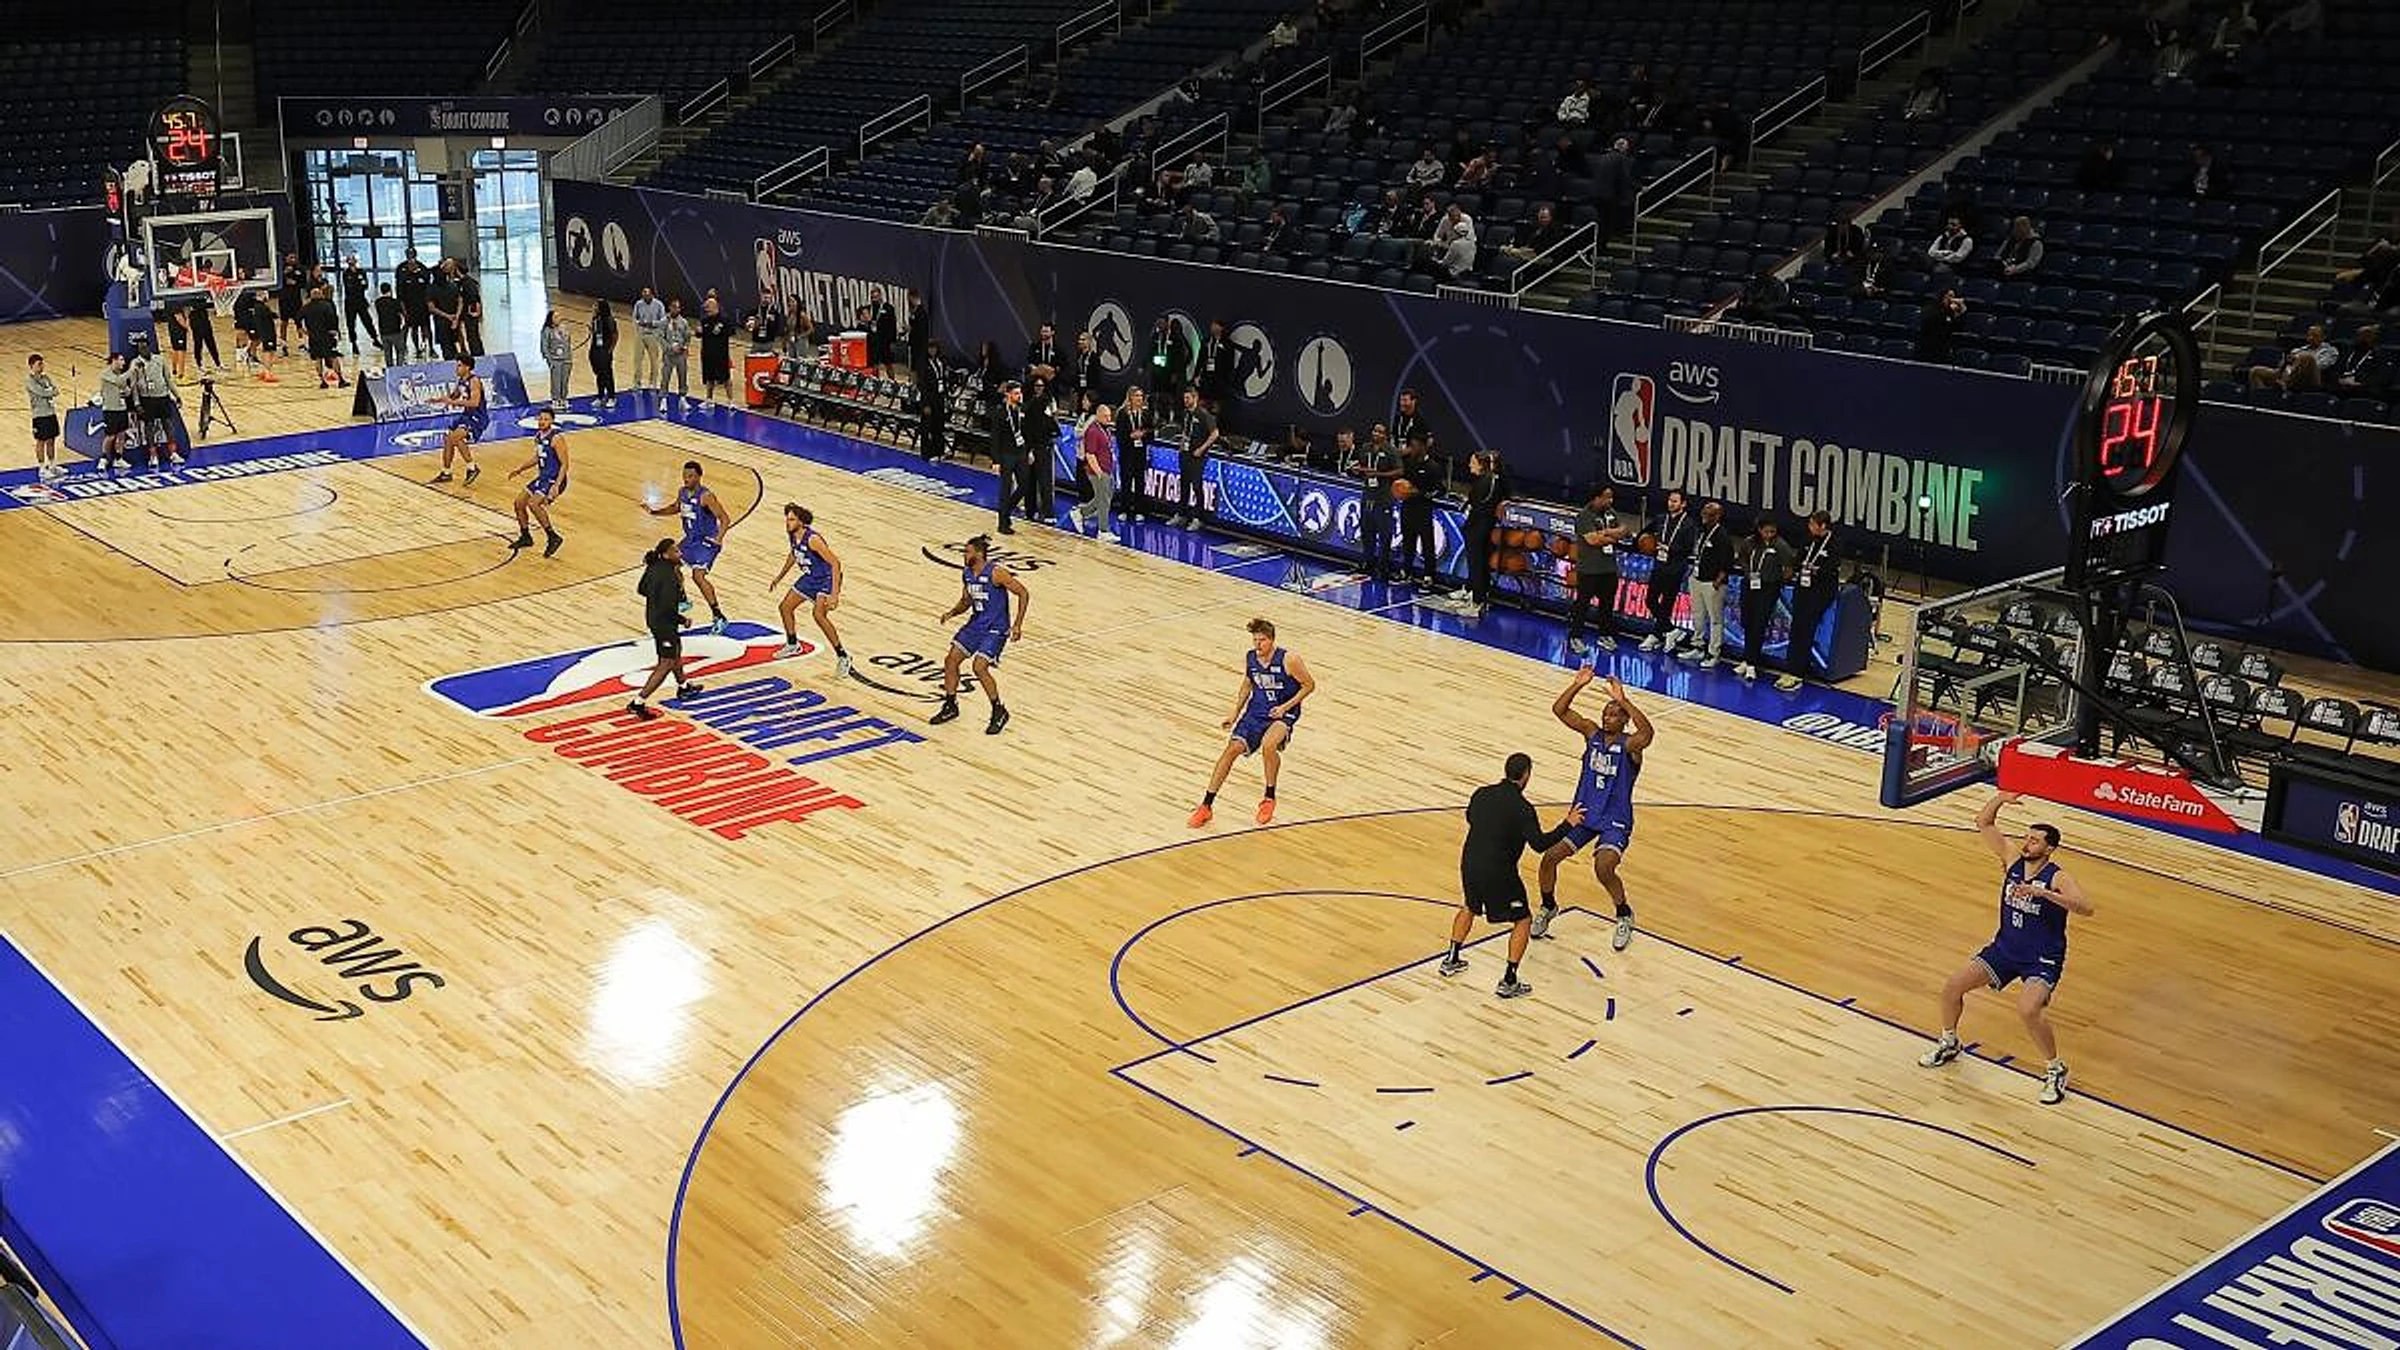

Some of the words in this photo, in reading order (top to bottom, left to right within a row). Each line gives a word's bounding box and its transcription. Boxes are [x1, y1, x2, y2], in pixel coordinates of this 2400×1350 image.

[162, 113, 196, 129] 45.7
[168, 128, 206, 160] 24
[779, 266, 834, 326] DRAFT
[1669, 360, 1720, 387] aws
[2102, 396, 2161, 476] 24
[63, 472, 187, 498] DRAFT
[183, 449, 350, 483] COMBINE
[1660, 415, 1784, 510] DRAFT
[1788, 438, 1984, 552] COMBINE
[2114, 502, 2170, 533] TISSOT
[658, 676, 929, 767] DRAFT
[523, 707, 868, 842] COMBINE
[288, 919, 446, 1002] aws
